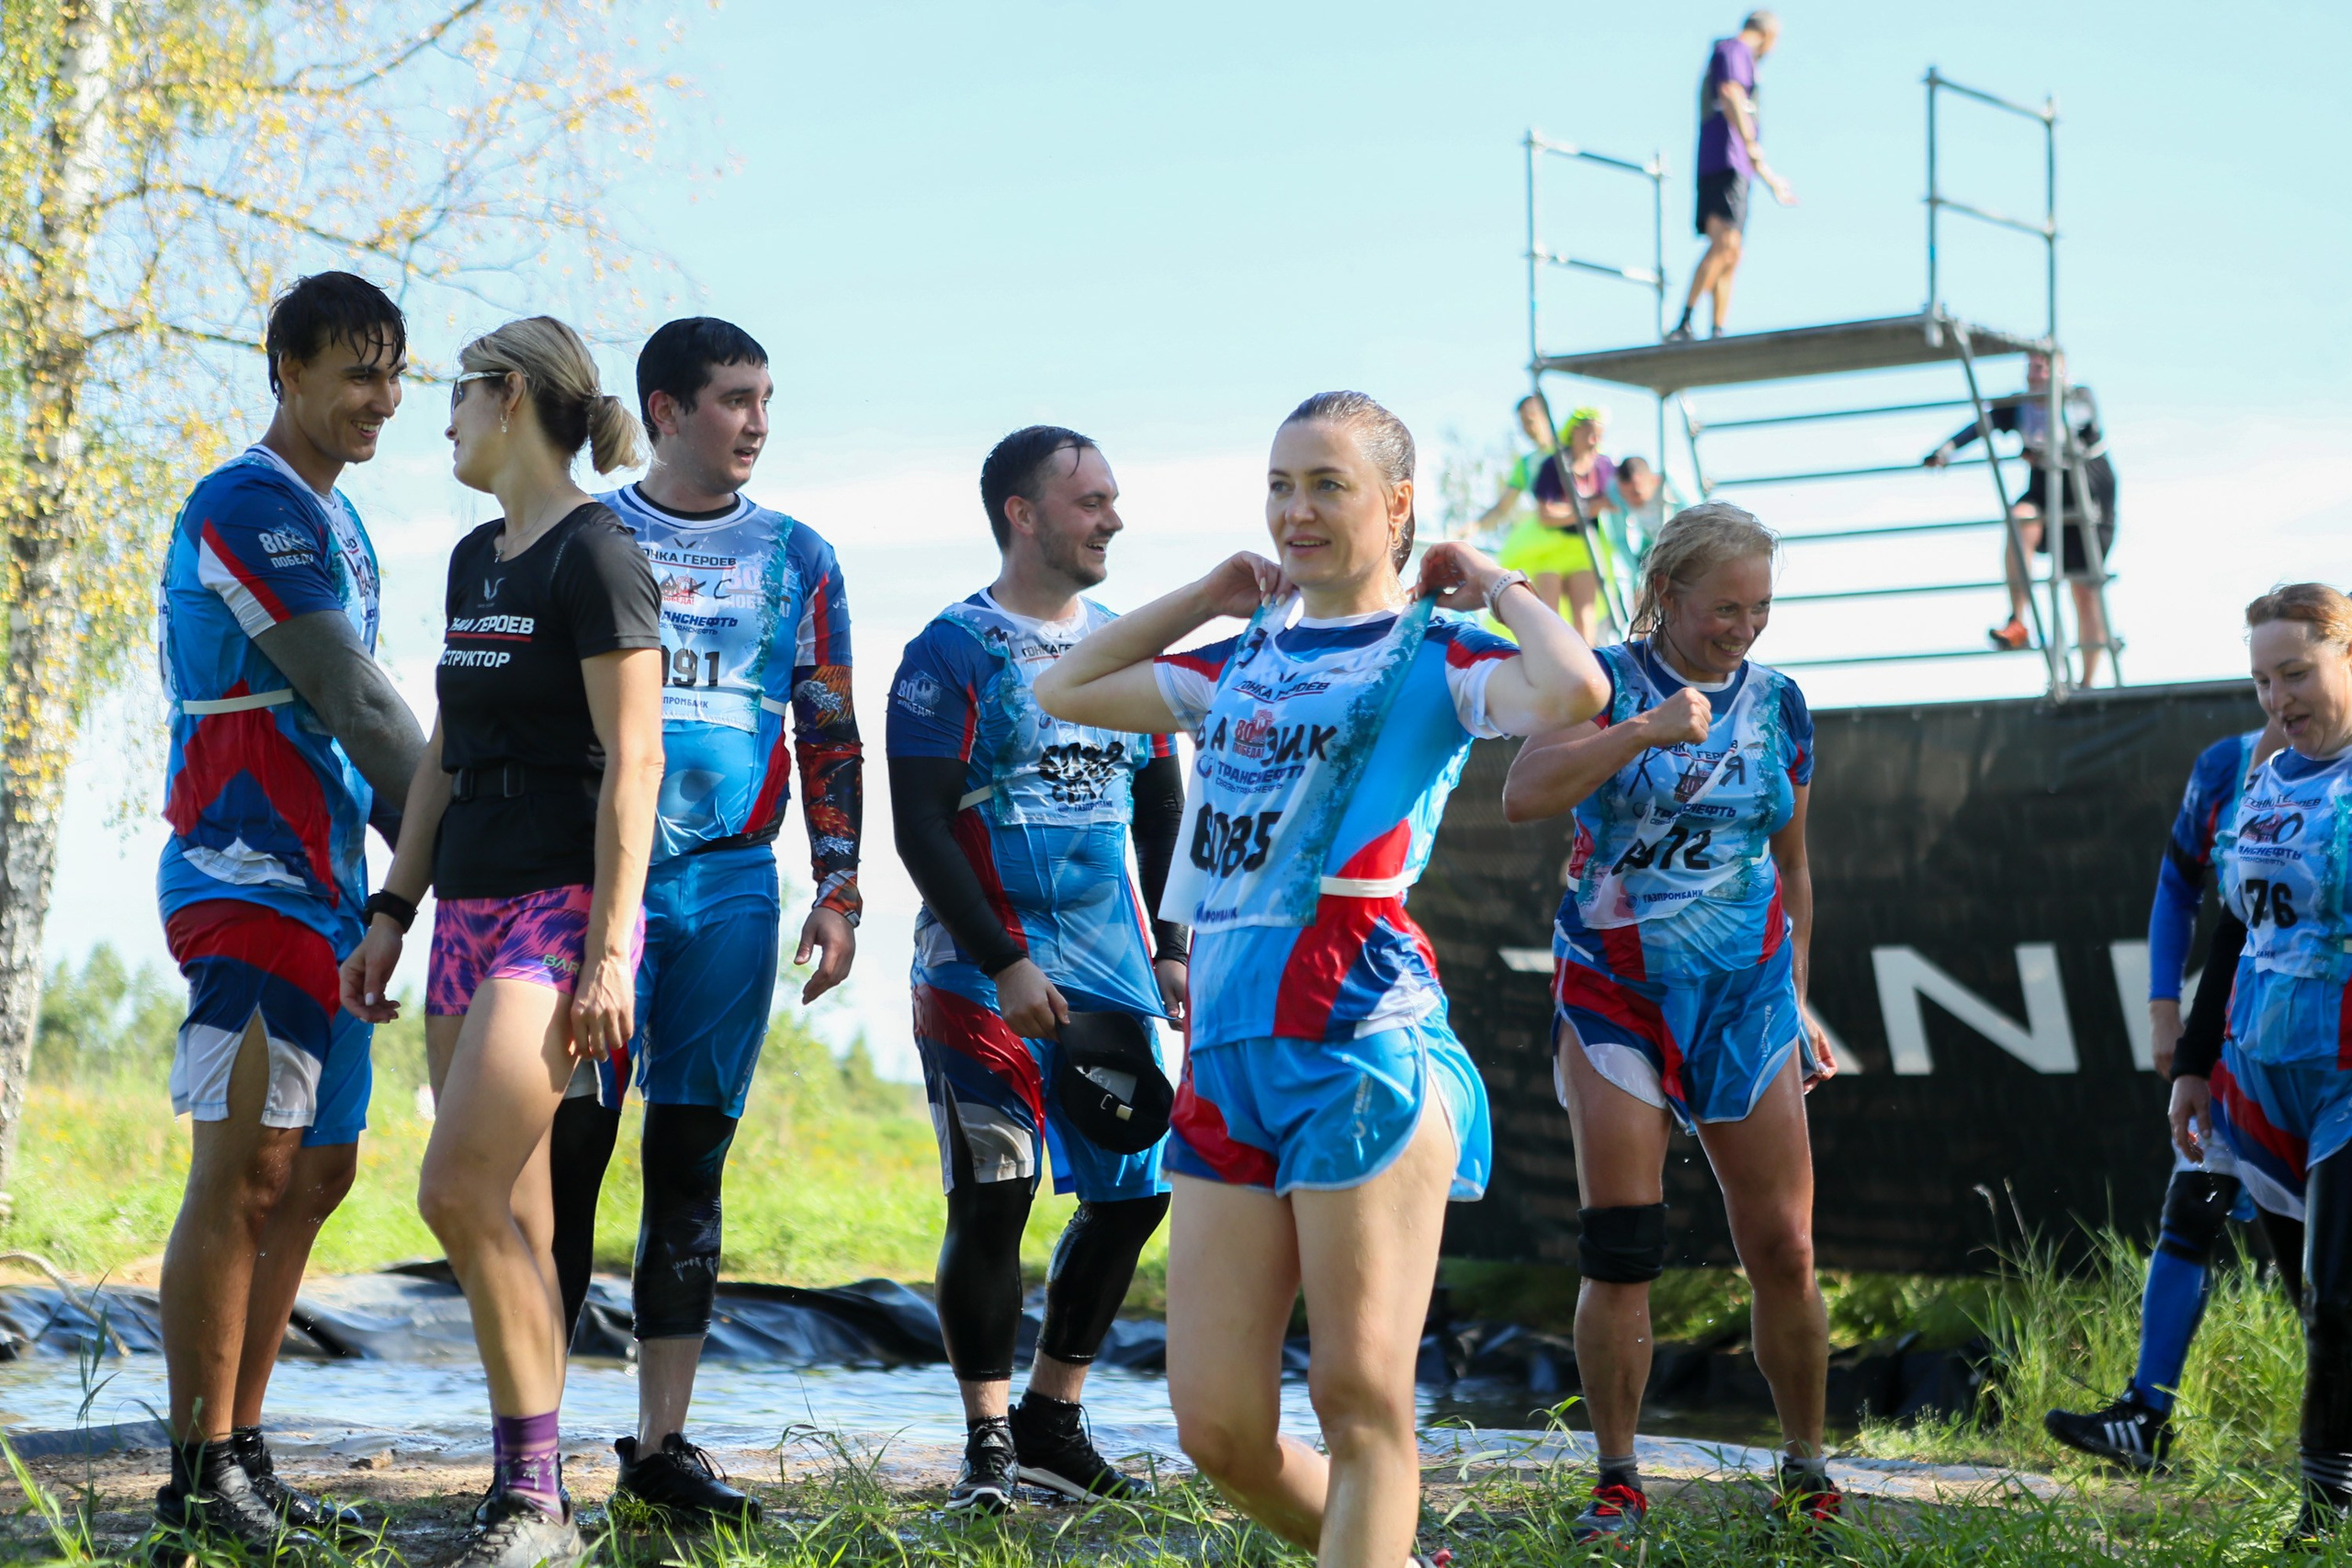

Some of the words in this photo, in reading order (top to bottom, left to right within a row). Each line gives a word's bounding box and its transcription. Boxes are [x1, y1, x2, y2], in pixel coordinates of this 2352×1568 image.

[683, 553, 737, 566] ГЕРОЕВ
[470, 615, 535, 635] ГЕРОЕВ
[1189, 802, 1284, 880] 6085
[1643, 889, 1704, 904] ГАЗПРОМБАНК
